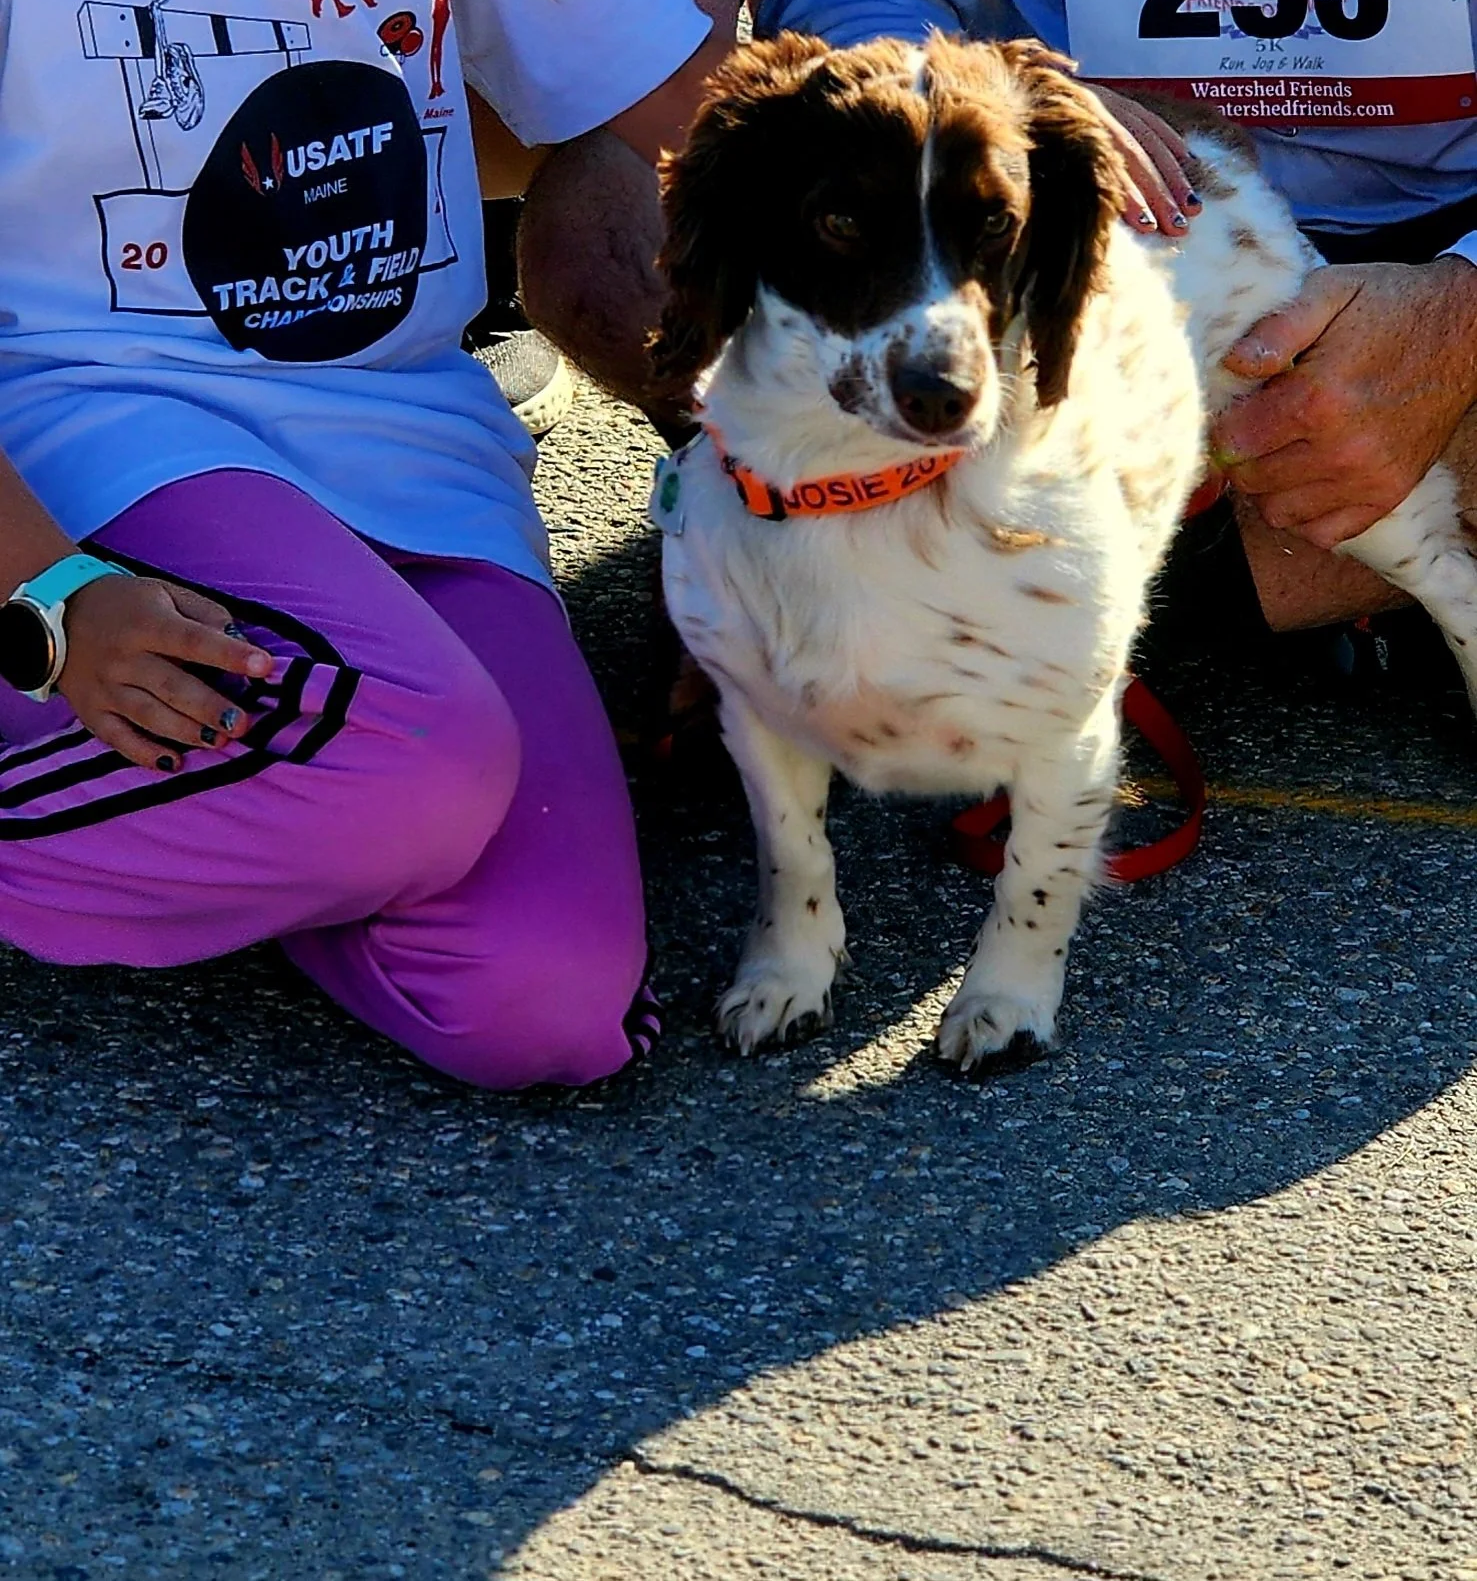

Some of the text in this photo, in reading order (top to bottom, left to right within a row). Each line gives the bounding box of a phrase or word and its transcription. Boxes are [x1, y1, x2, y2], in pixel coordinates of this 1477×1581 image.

[1252, 57, 1275, 73] Jog
[1292, 56, 1325, 70] Walk
[1191, 80, 1353, 98] Watershed Friends
[286, 122, 394, 178] USATF
[303, 178, 349, 205] MAINE
[121, 242, 168, 270] 20
[283, 220, 394, 271] YOUTH
[212, 247, 420, 311] TRACK & FIELD
